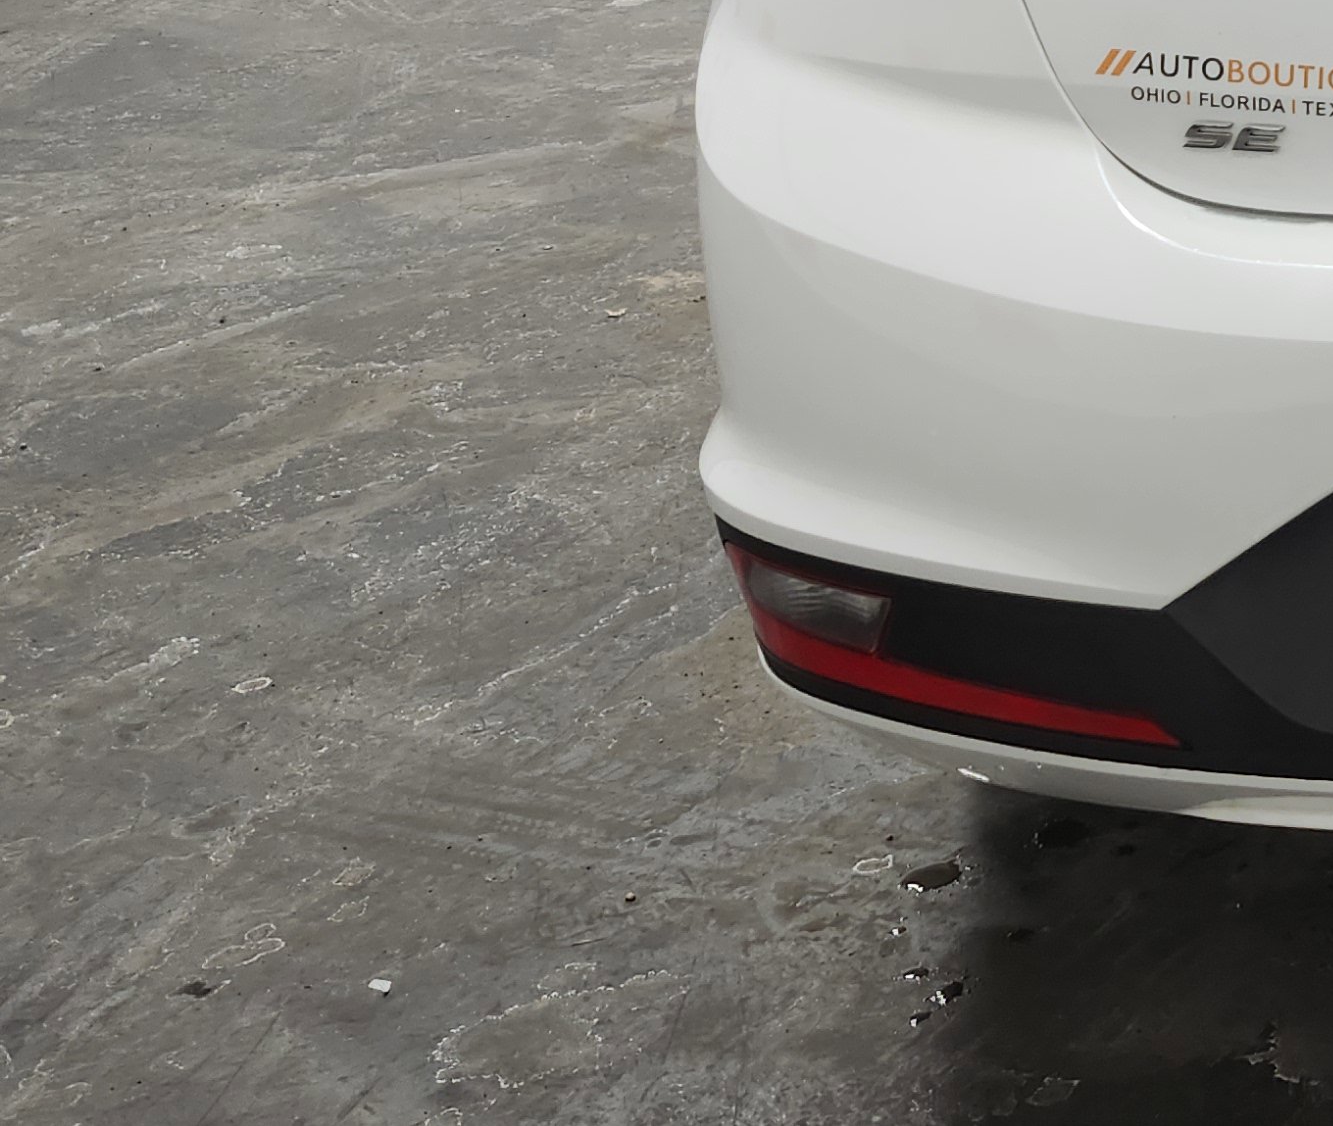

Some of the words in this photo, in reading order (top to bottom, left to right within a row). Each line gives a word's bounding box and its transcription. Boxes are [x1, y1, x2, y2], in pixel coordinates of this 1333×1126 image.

[1131, 86, 1181, 104] OHIO
[1199, 92, 1285, 113] FLORIDA
[1182, 120, 1286, 153] SE
